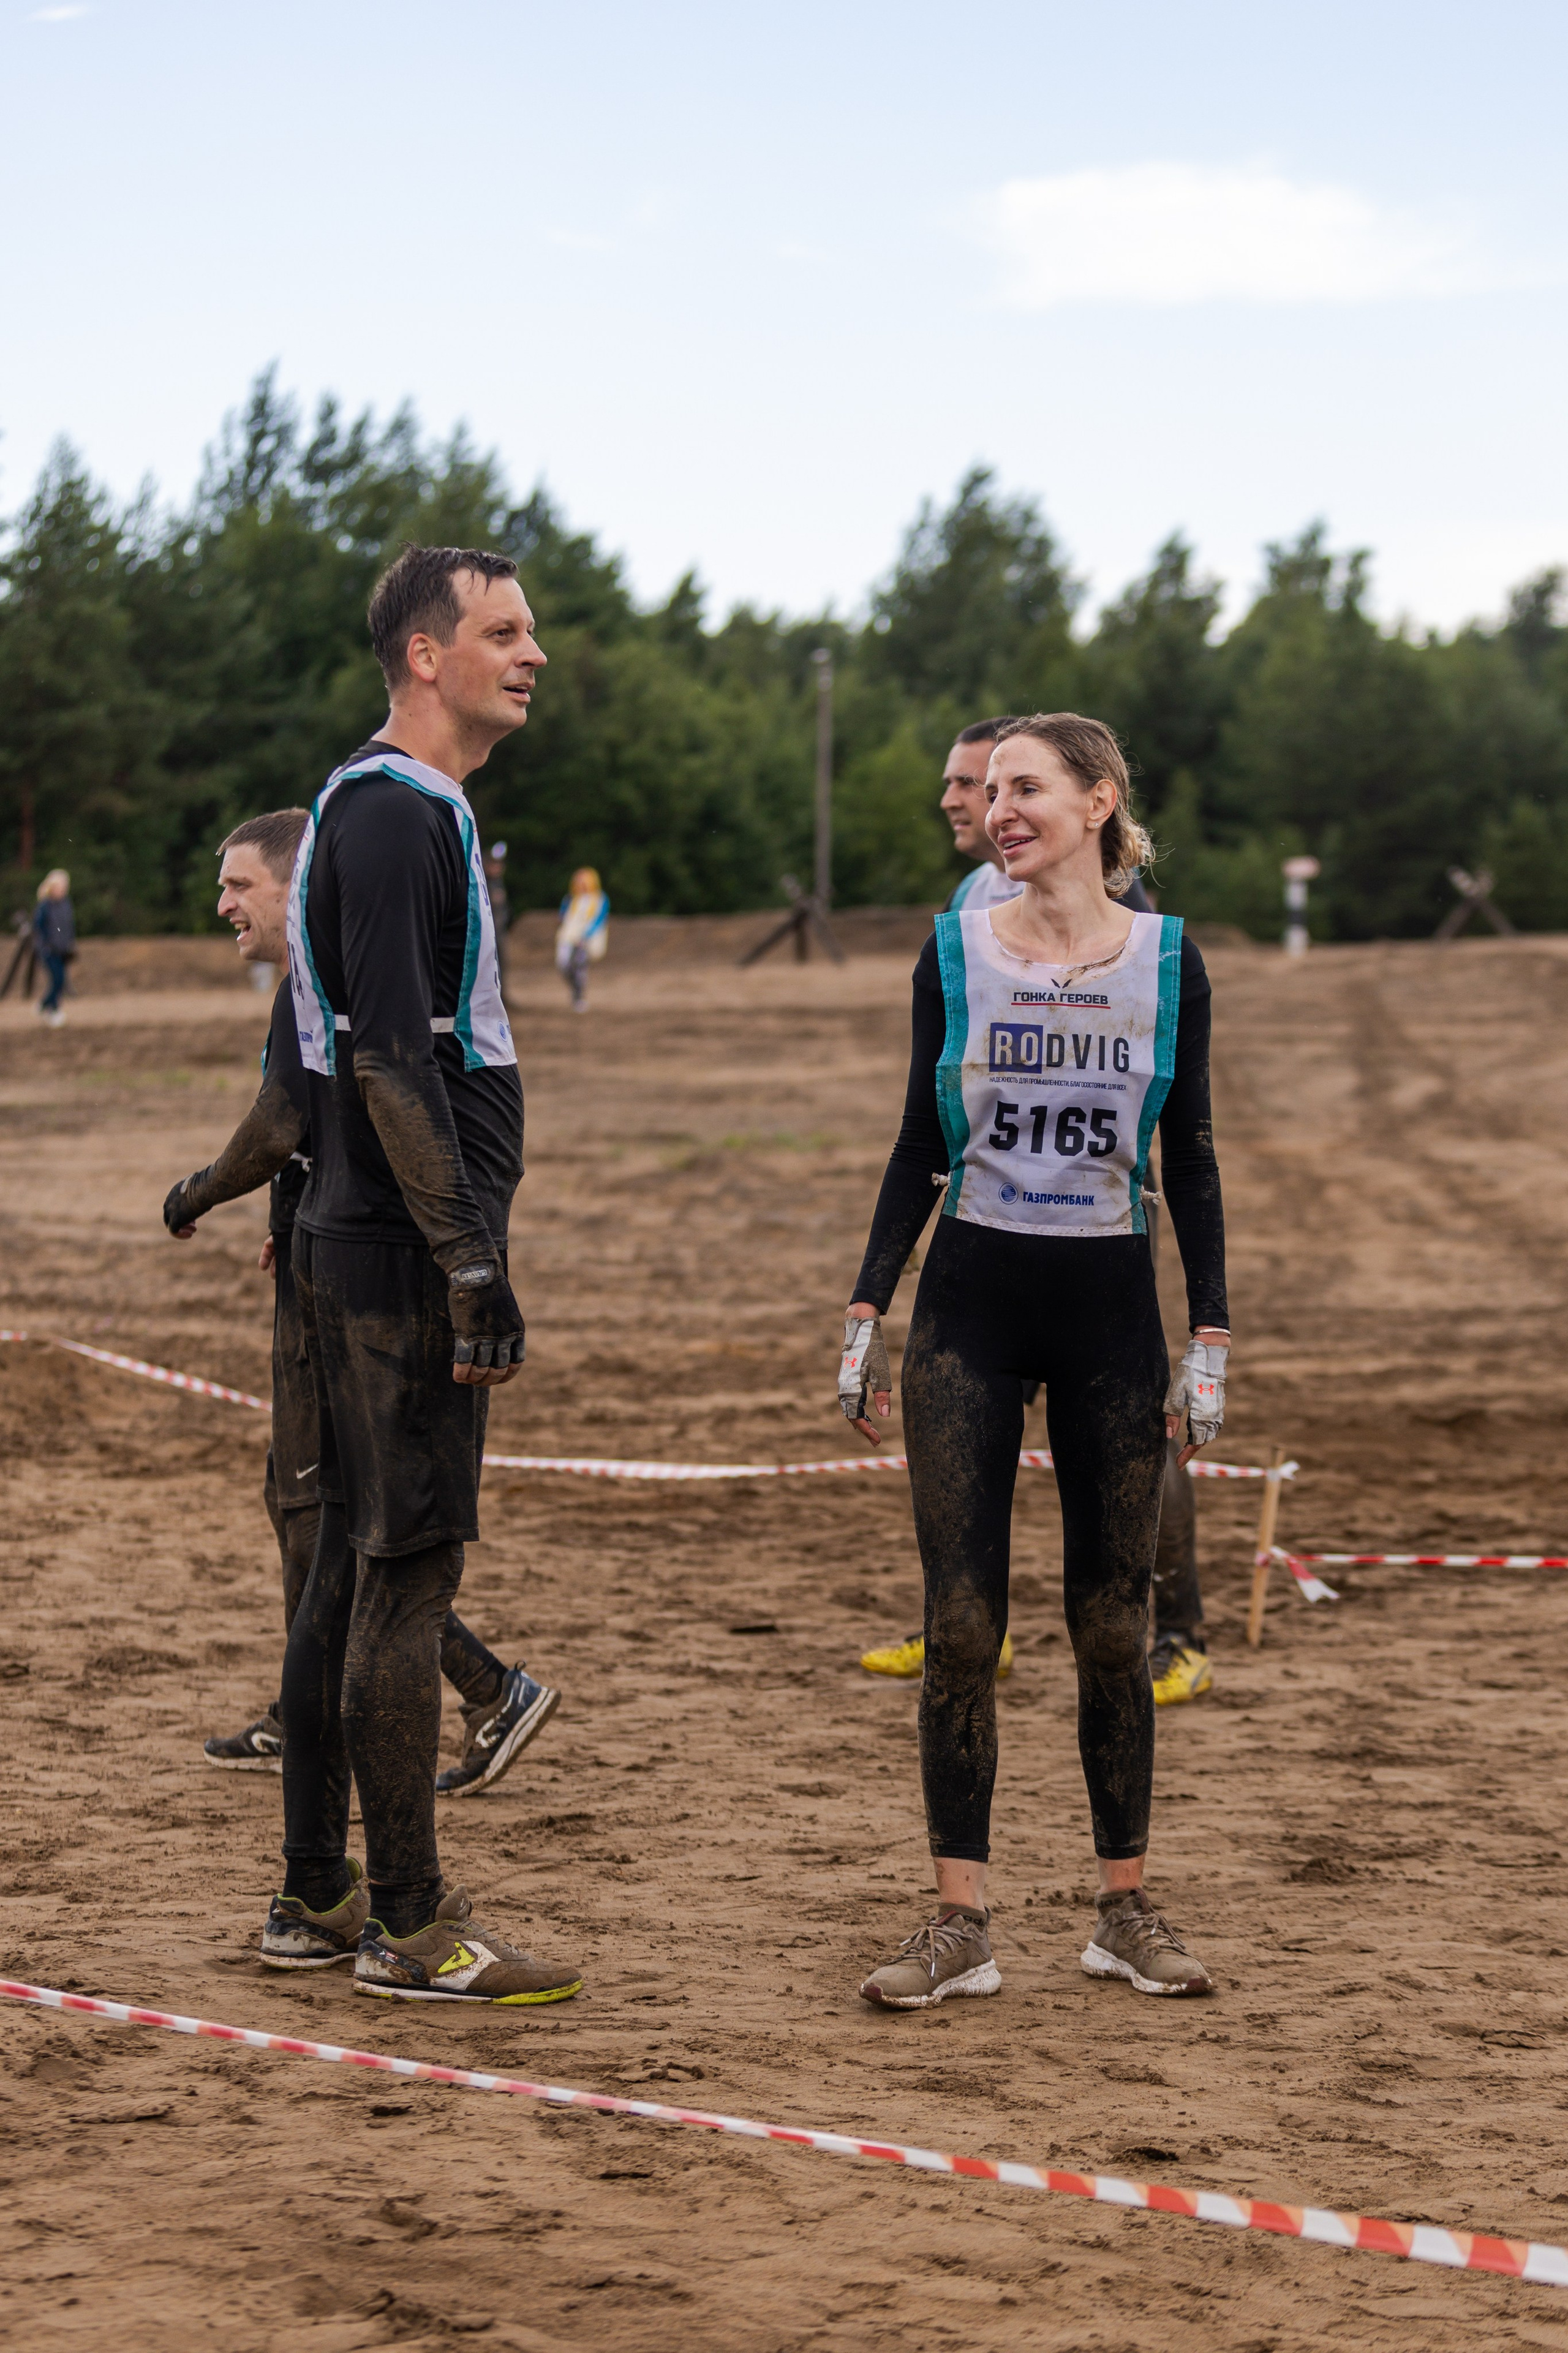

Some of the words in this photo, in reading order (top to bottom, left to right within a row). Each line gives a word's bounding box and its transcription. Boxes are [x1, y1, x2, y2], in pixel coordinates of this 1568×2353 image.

[1014, 992, 1055, 1002] ГОНКА
[1060, 993, 1108, 1005] ГЕРОЕВ
[994, 1030, 1129, 1073] RODVIG
[1070, 1081, 1107, 1089] БЛАГОСОСТОЯНИЕ
[989, 1100, 1118, 1157] 5165
[1022, 1192, 1095, 1206] ГАЗПРОМБАНК
